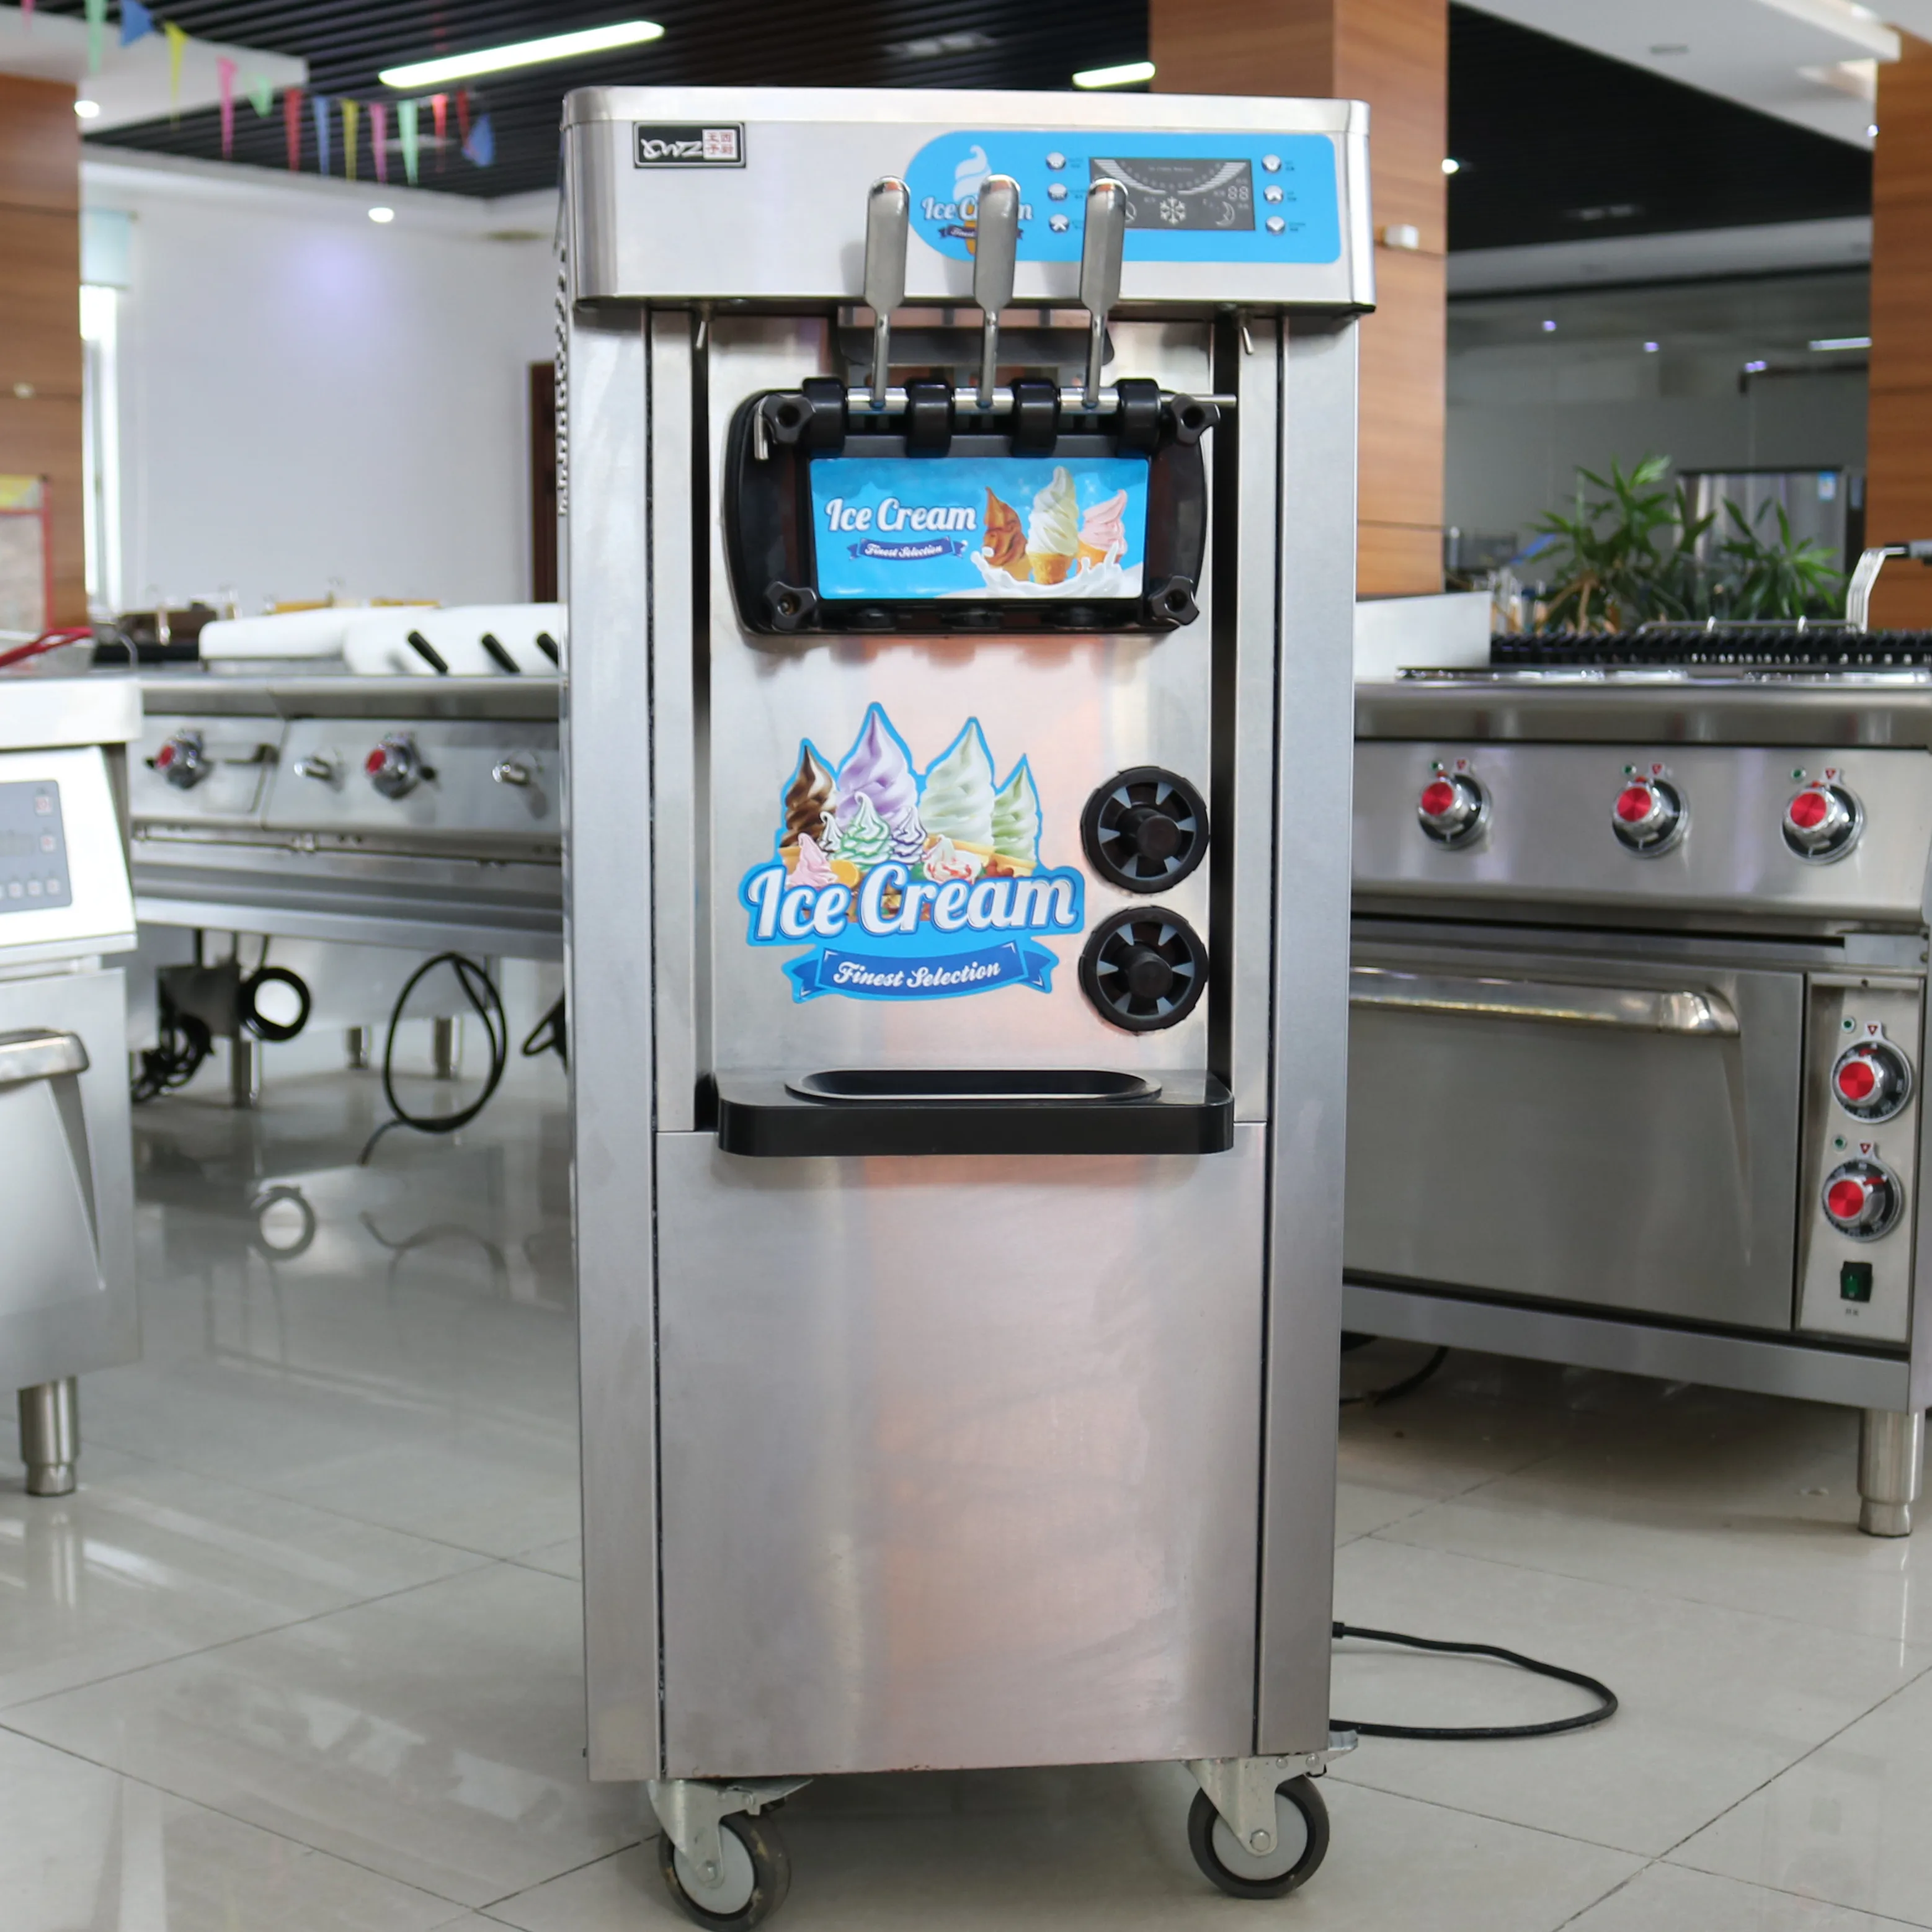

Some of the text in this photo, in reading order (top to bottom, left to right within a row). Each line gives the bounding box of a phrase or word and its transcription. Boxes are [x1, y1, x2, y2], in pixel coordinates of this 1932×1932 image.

[921, 196, 957, 220] Ice
[825, 497, 977, 532] Ice Cream
[865, 543, 943, 558] Finest Selection
[747, 861, 1079, 938] Ice Cream
[833, 961, 1001, 988] Finest Selection
